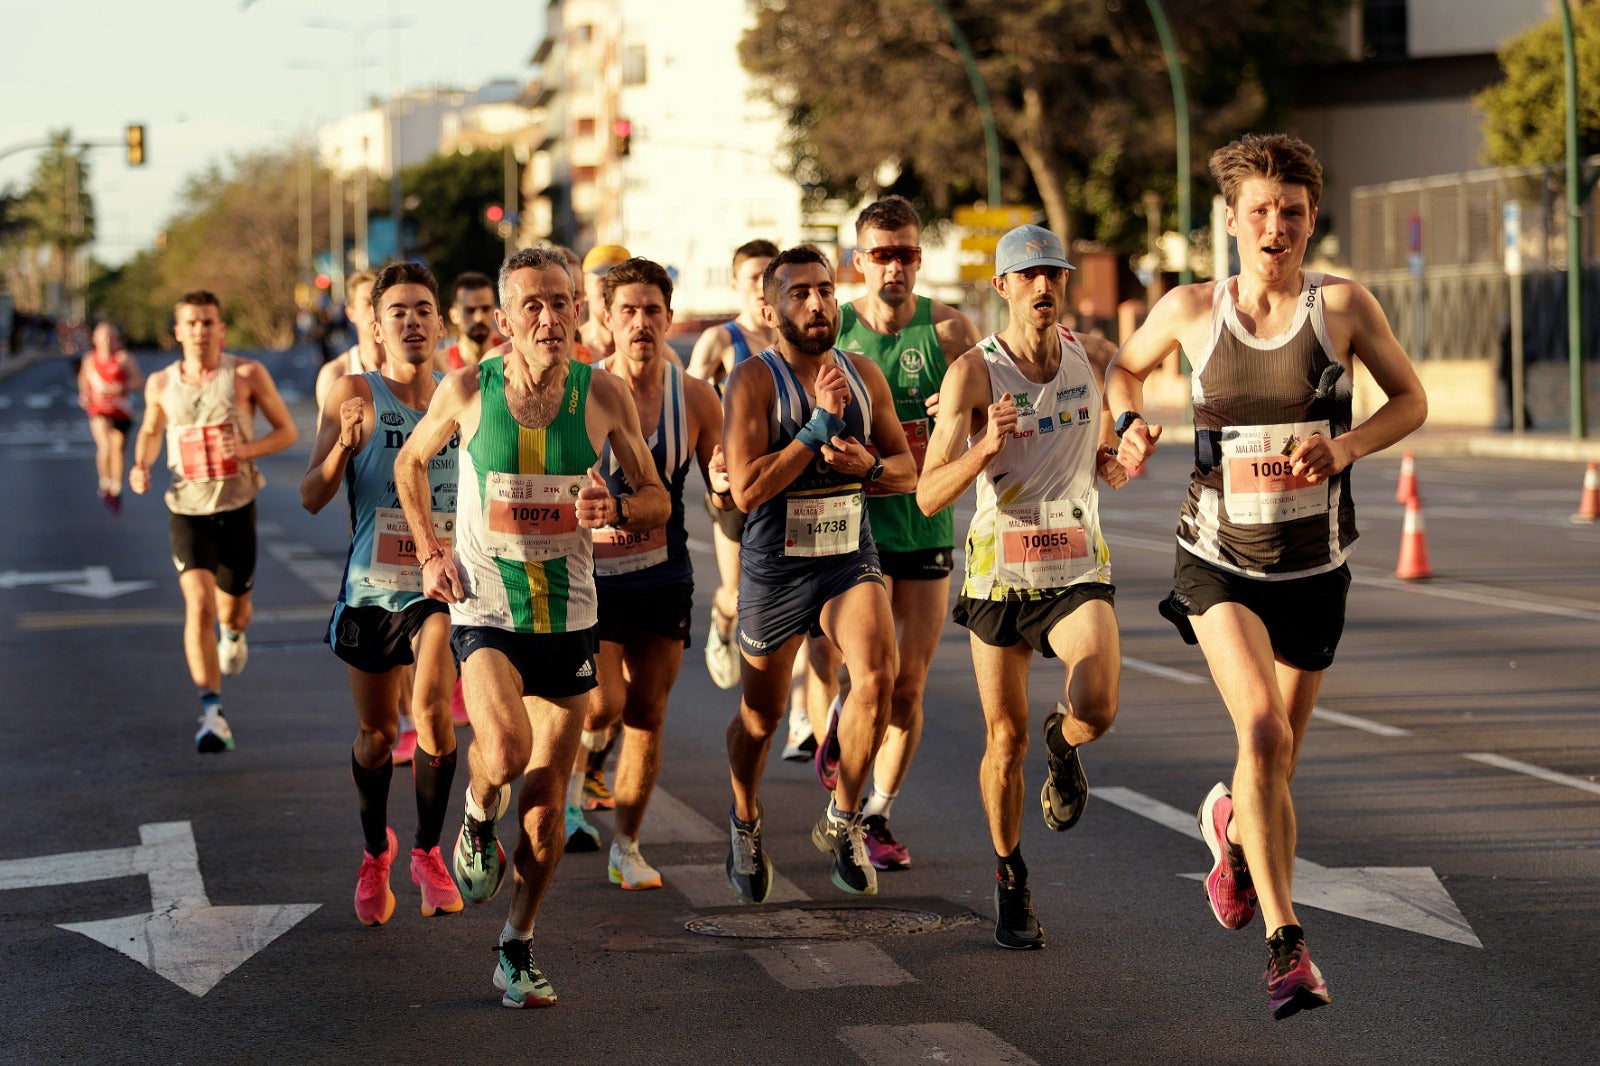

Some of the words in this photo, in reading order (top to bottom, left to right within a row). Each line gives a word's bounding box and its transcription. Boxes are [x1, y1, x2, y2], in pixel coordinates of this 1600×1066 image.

[1305, 283, 1318, 309] soar
[568, 386, 579, 416] soar
[1012, 429, 1035, 440] EJOT
[1282, 435, 1301, 443] 2K
[1251, 461, 1293, 478] 1005
[543, 486, 561, 494] 21K
[511, 507, 561, 522] 10074
[1049, 511, 1065, 519] 21K
[806, 519, 848, 535] 14738
[609, 532, 651, 547] 10083
[1022, 532, 1069, 549] 10055
[740, 629, 768, 649] TRIMTEX
[575, 669, 593, 677] adidas
